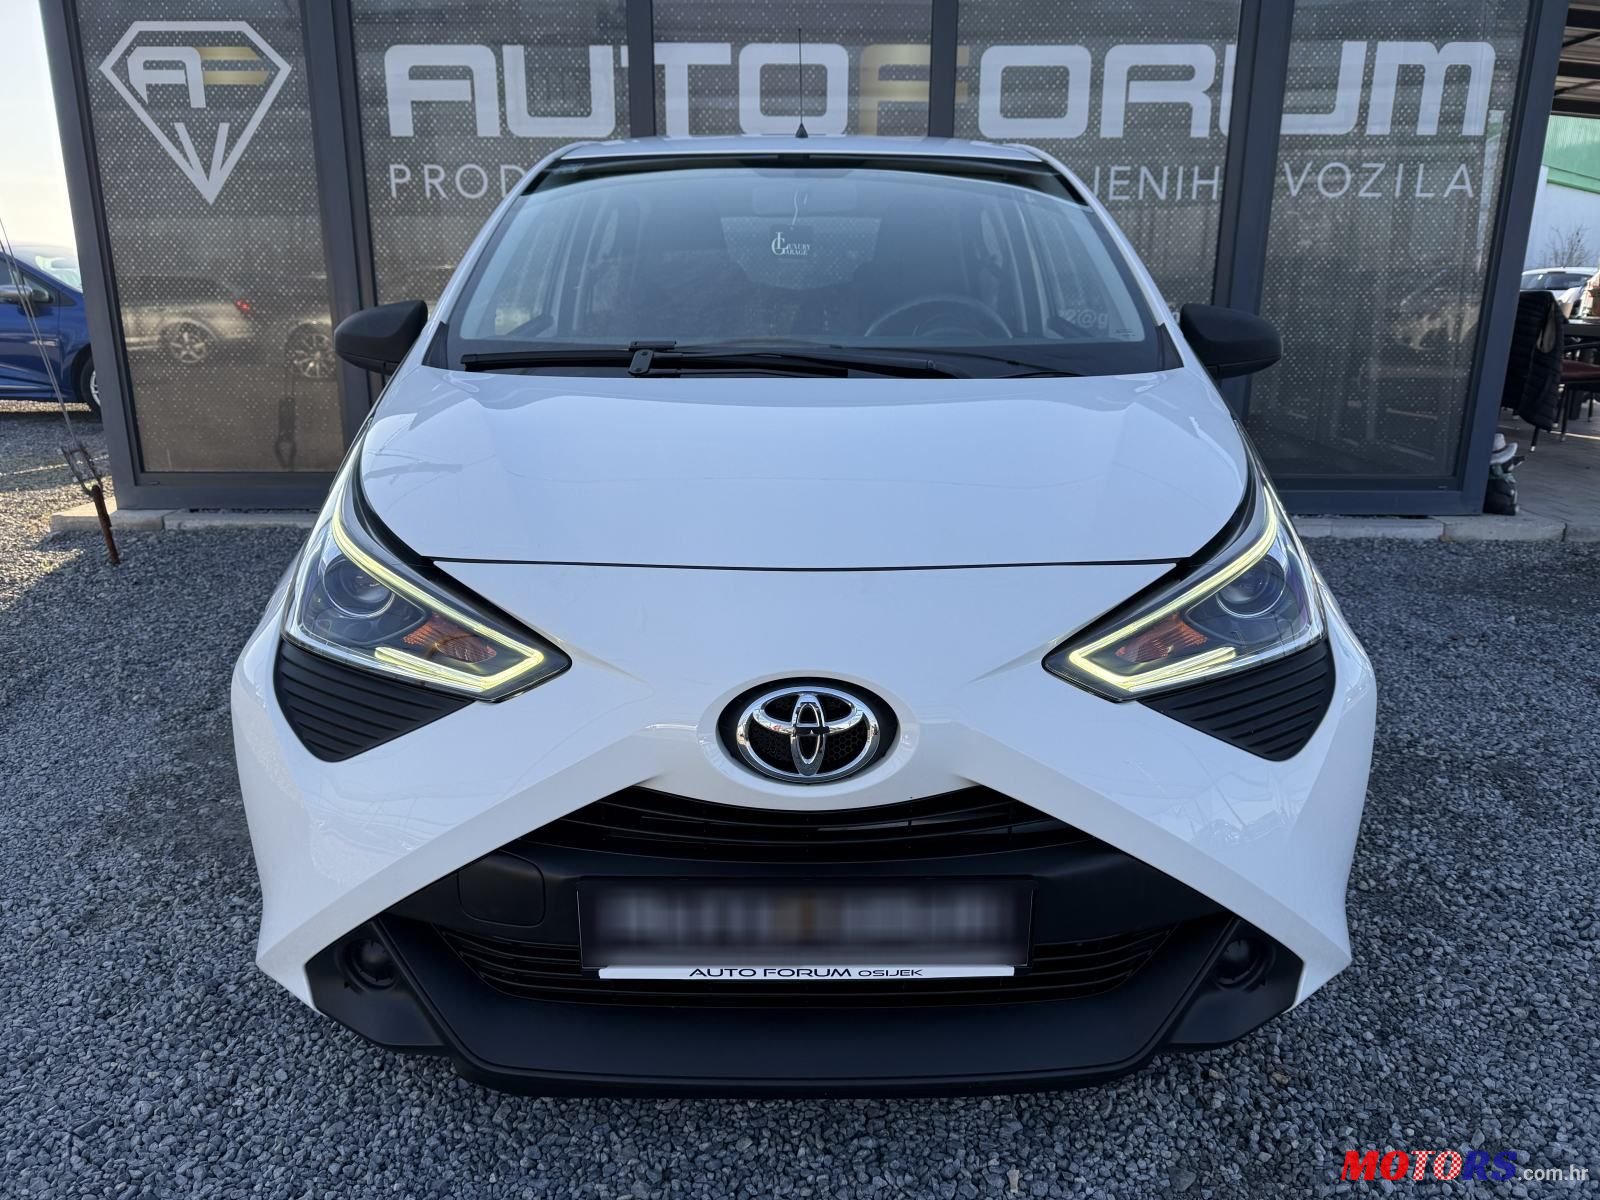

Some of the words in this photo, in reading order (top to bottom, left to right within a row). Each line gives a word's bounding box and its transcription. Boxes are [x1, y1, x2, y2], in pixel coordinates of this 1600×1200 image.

[1284, 161, 1474, 198] VOZILA
[689, 968, 757, 978] AUTO
[763, 968, 852, 978] FORUM
[858, 969, 923, 978] OSIJEK
